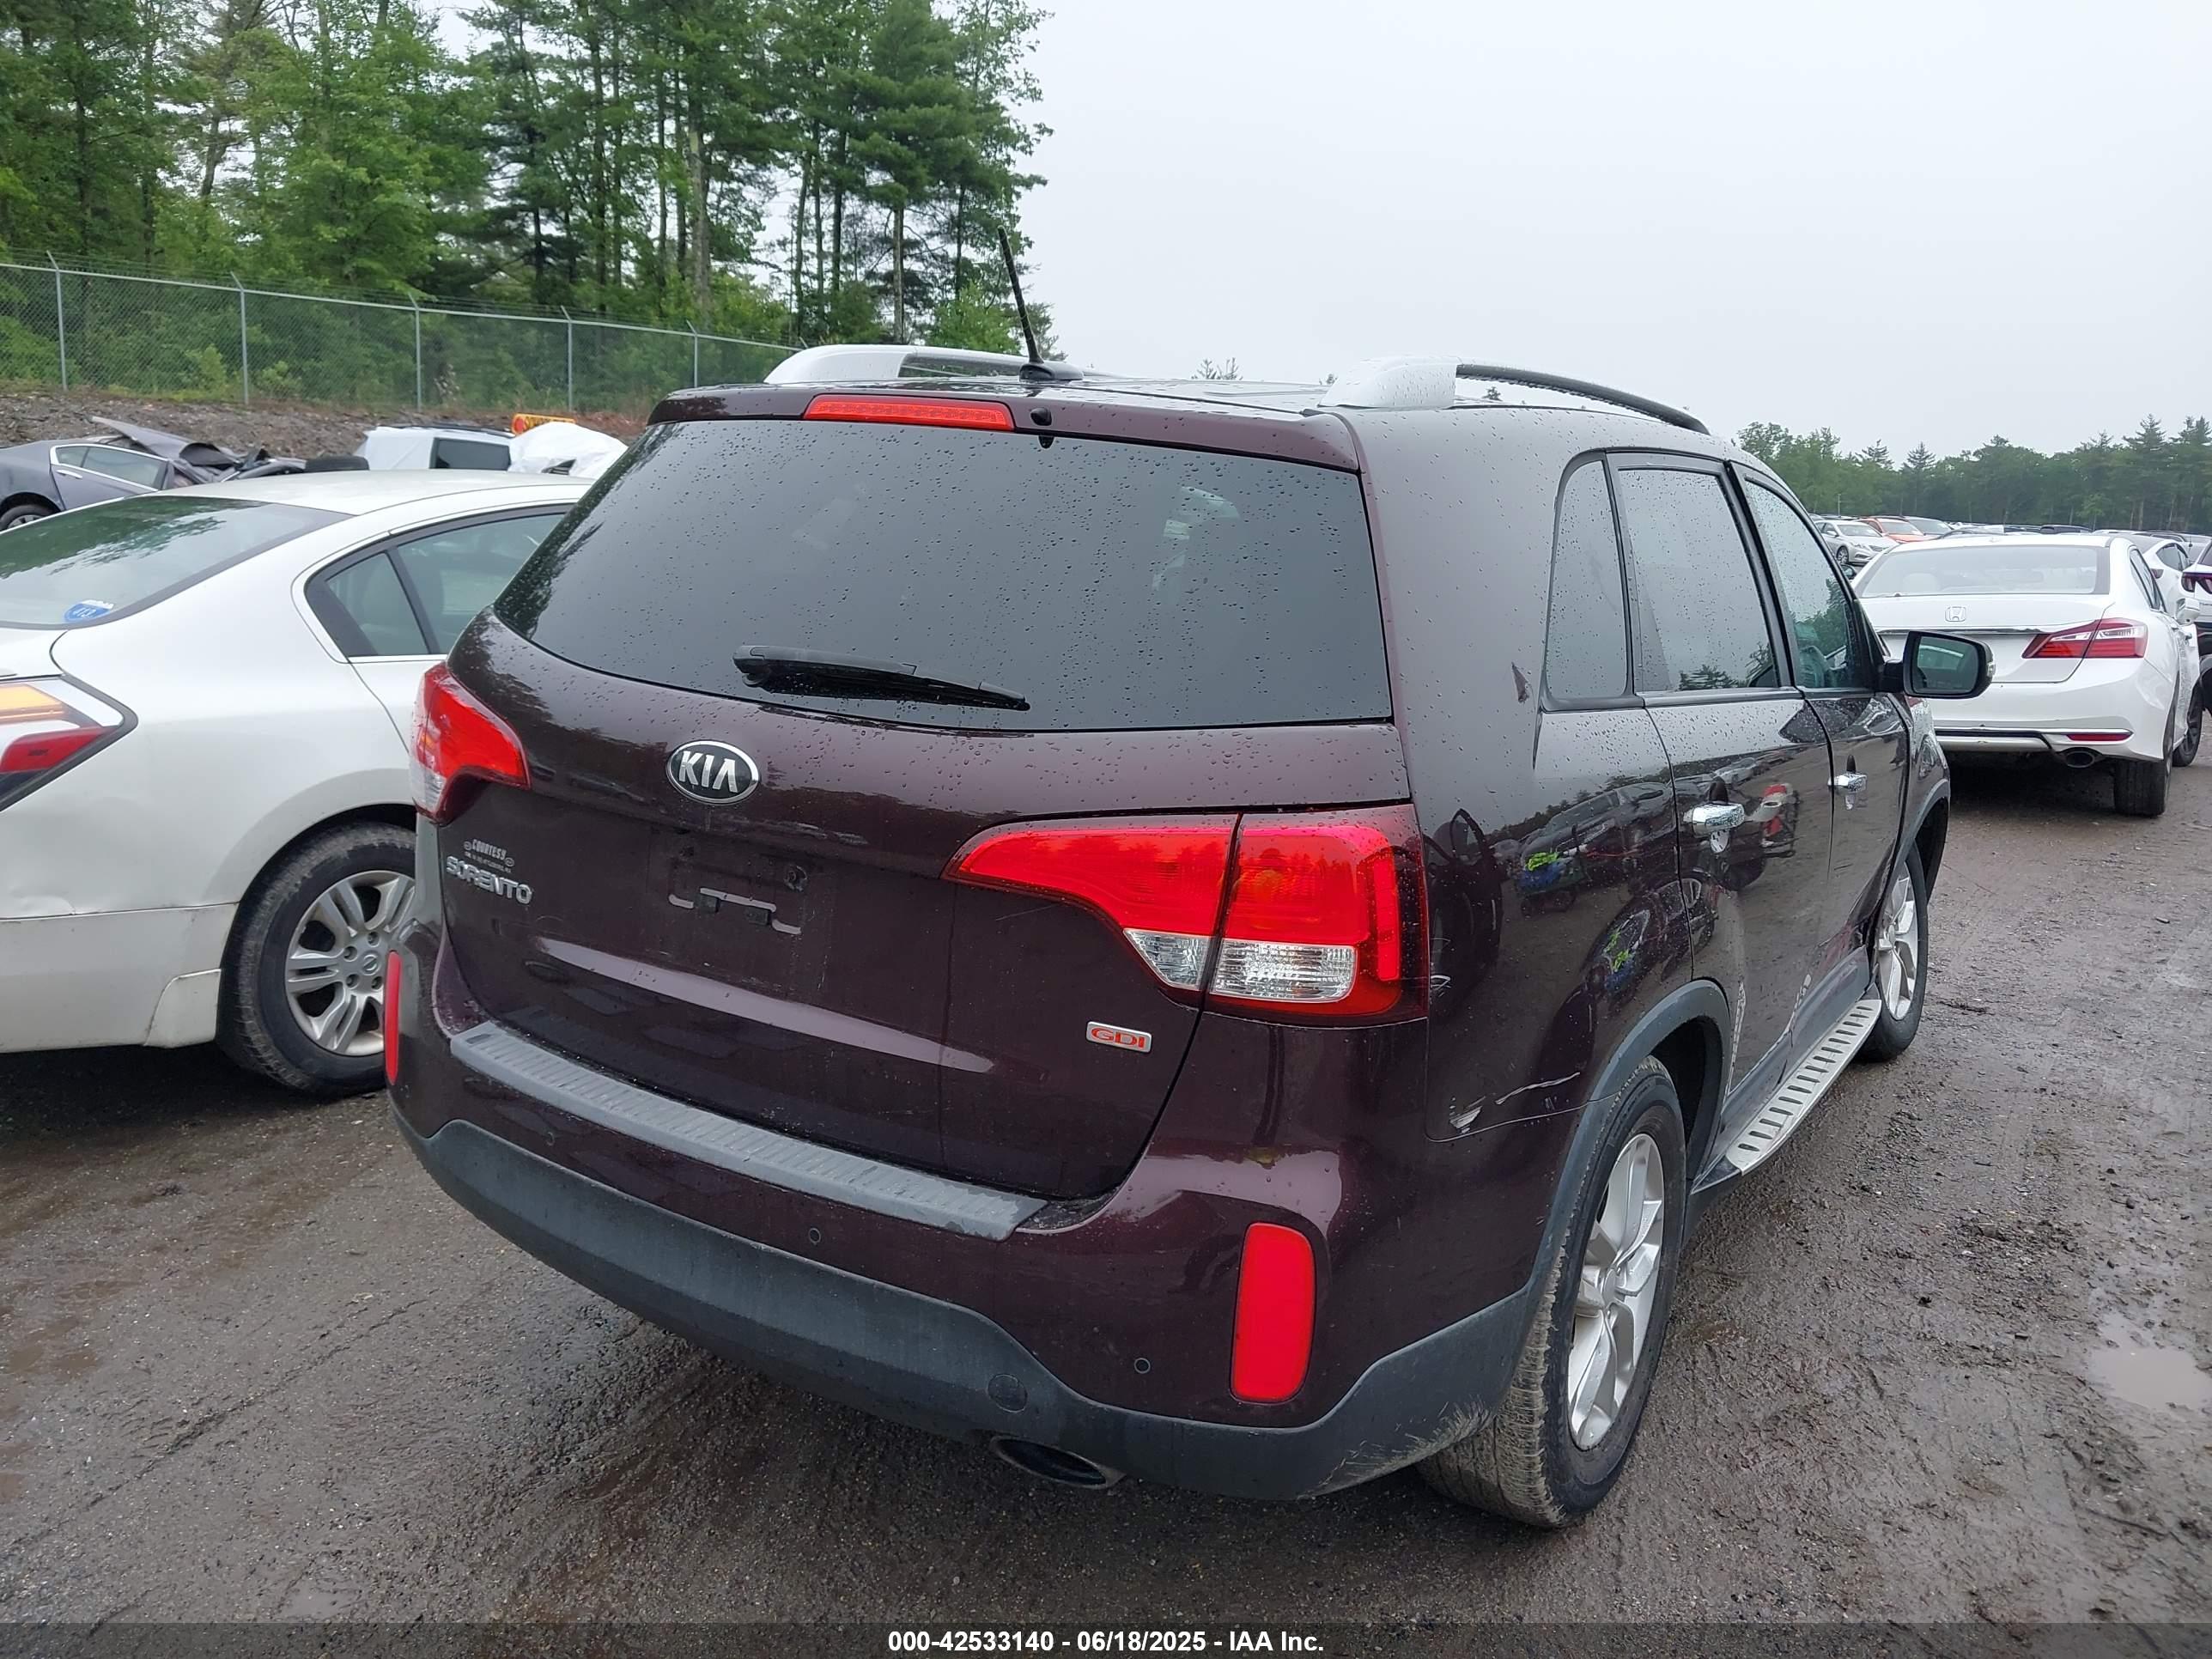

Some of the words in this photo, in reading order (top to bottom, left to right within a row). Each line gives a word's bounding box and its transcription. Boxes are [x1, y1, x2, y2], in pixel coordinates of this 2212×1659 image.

[678, 750, 738, 793] KIA
[446, 855, 533, 904] SORENTO
[1091, 1027, 1146, 1048] GDI
